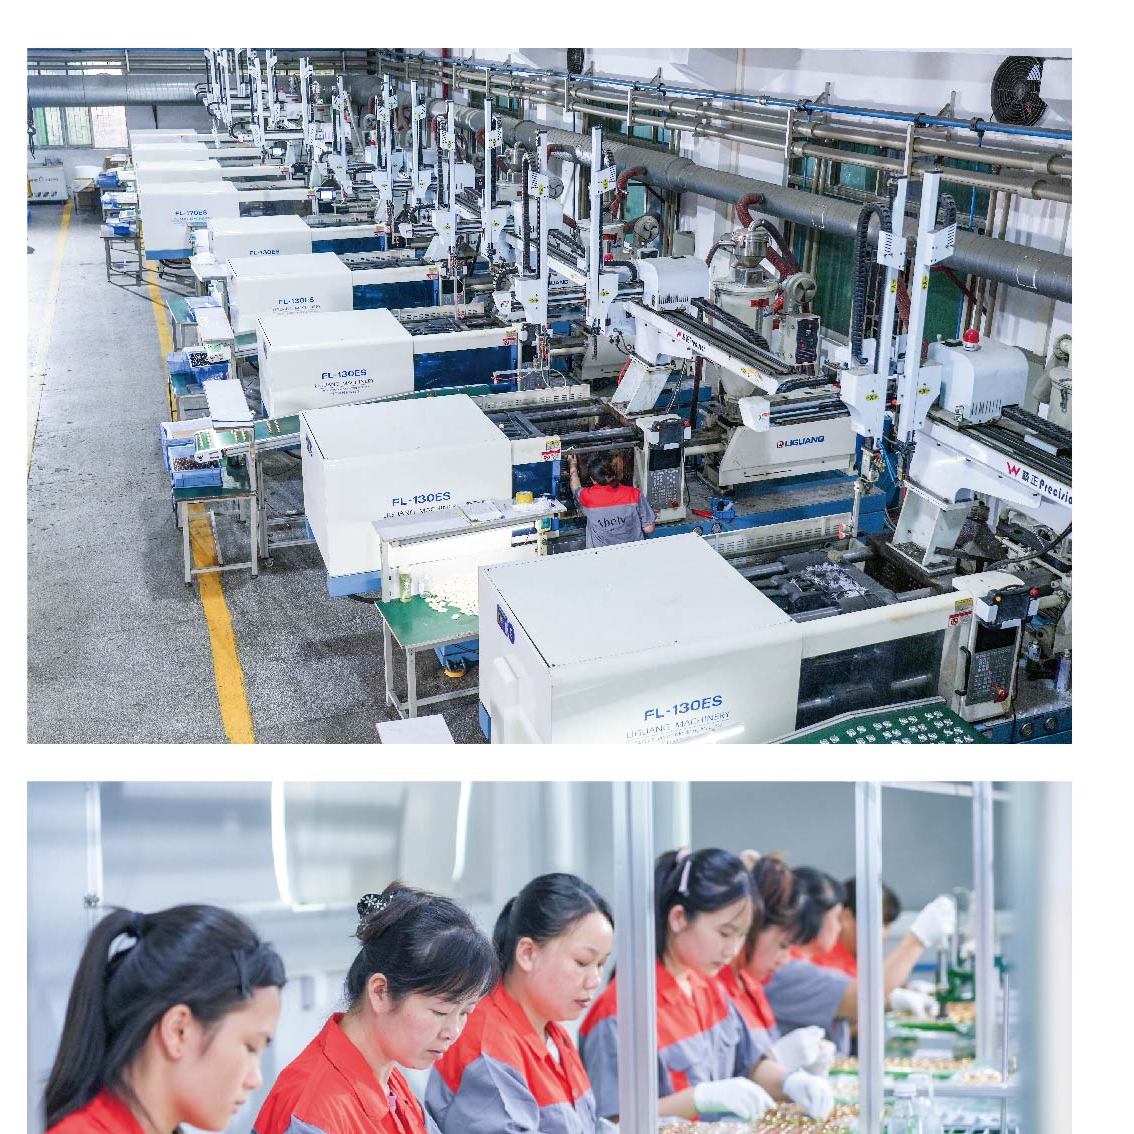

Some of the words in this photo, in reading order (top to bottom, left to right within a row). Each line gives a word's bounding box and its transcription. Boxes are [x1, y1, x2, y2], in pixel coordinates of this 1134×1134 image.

[321, 369, 367, 380] FL-130ES
[785, 435, 825, 448] LIGUANG
[392, 491, 451, 506] FL-130ES
[644, 695, 723, 721] FL-130ES
[675, 711, 731, 728] MACHINERY
